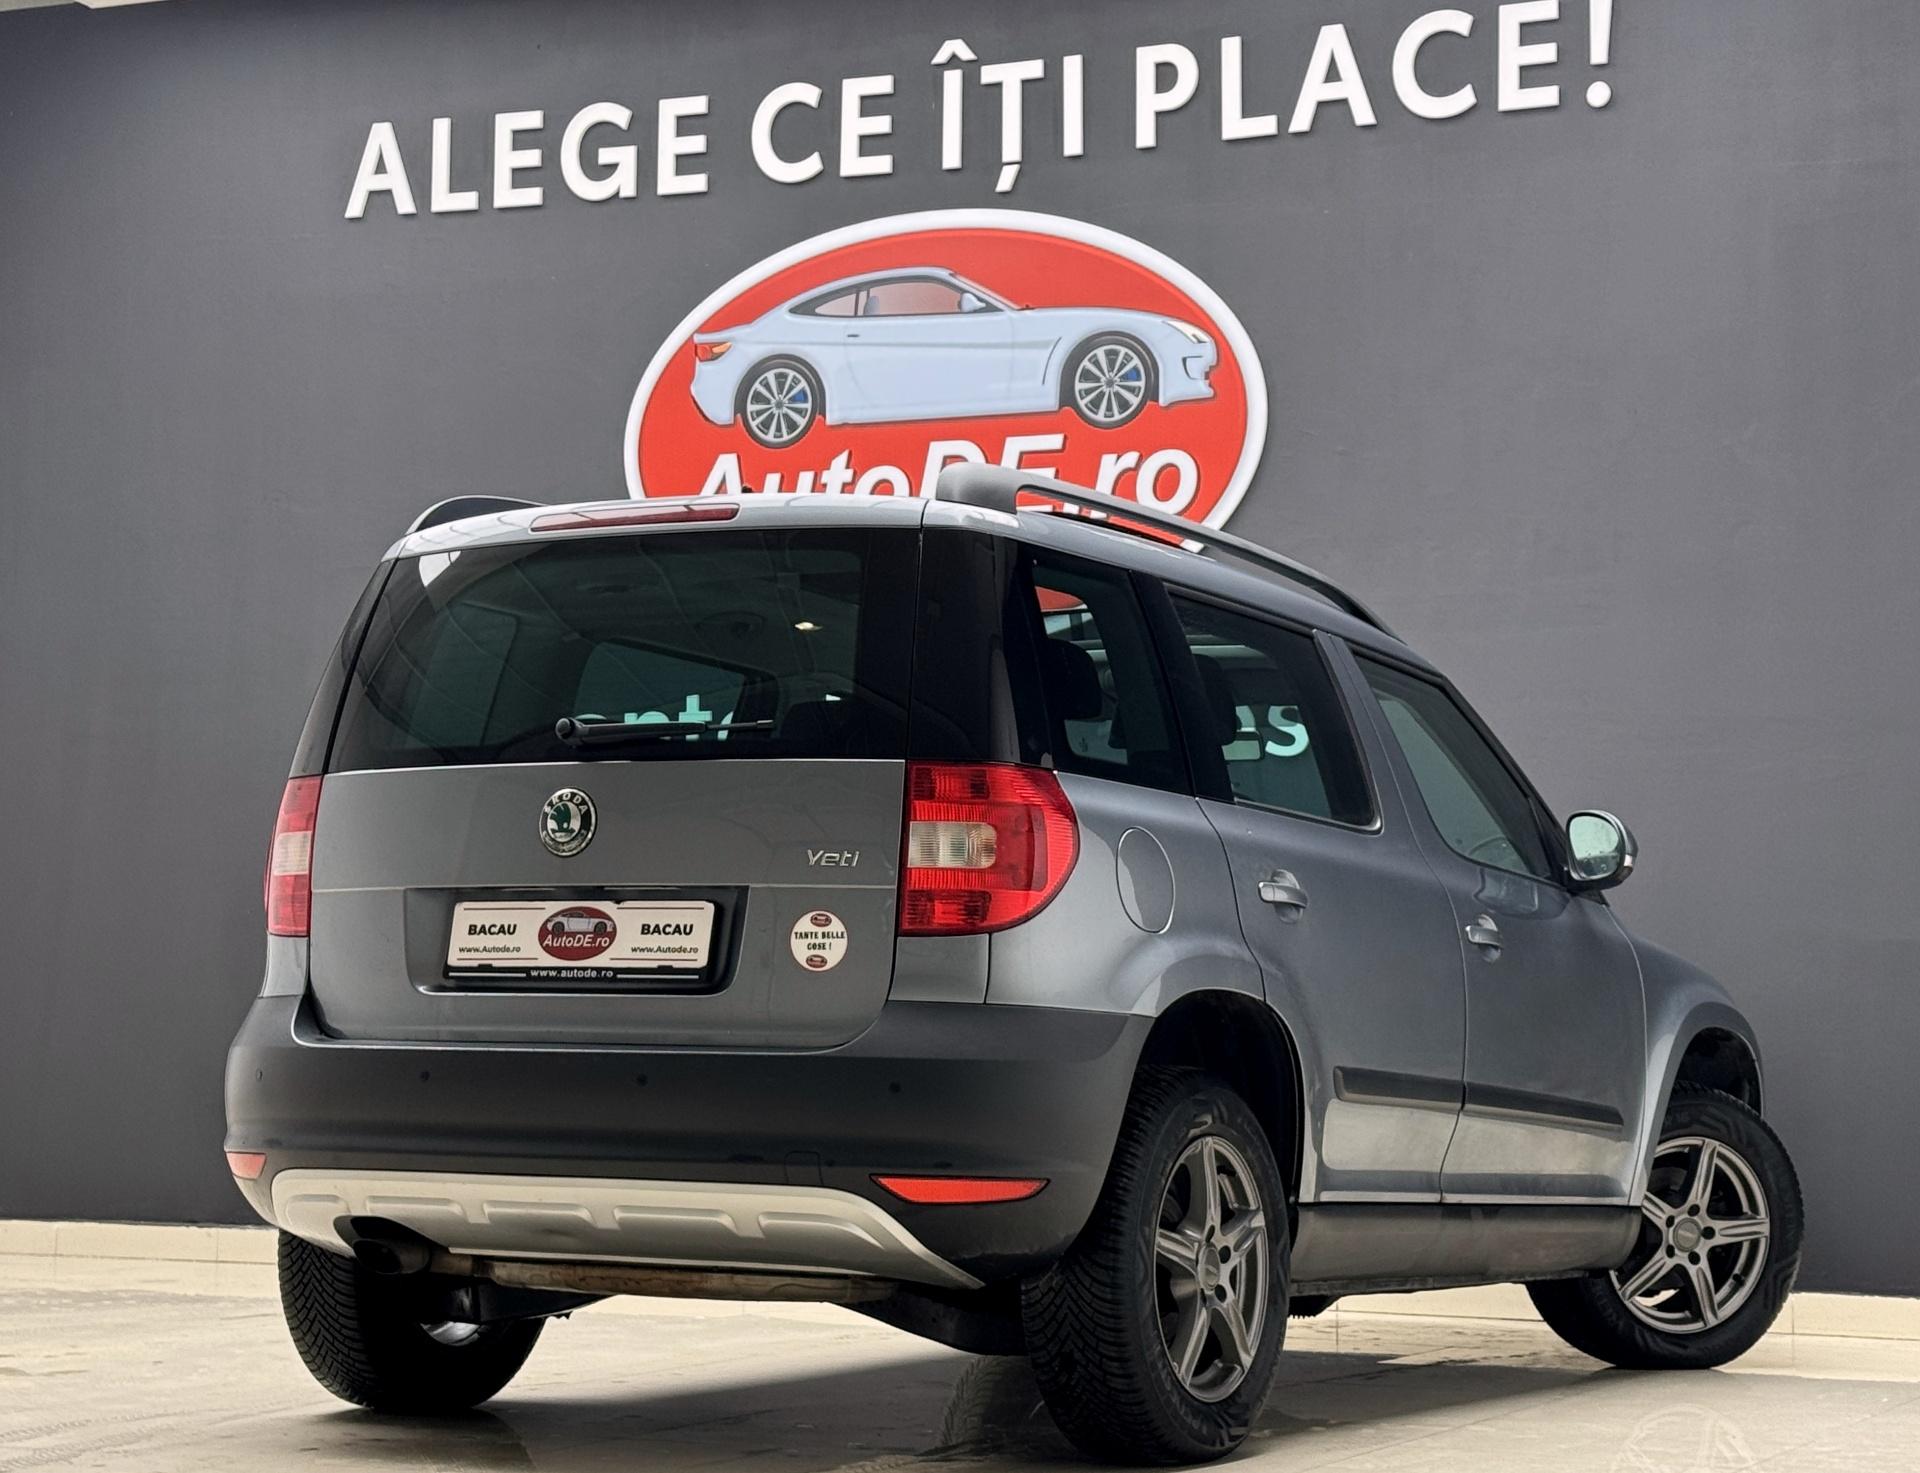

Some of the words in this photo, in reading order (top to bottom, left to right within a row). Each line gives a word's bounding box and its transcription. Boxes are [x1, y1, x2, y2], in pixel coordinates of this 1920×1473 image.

[344, 95, 709, 219] ALEGE
[750, 75, 894, 184] CE
[931, 38, 1085, 193] ÎȚI
[1134, 0, 1613, 150] PLACE!
[807, 848, 860, 868] Yeti
[467, 923, 518, 936] BACAU
[640, 923, 696, 937] BACAU
[793, 931, 819, 941] TANTE
[821, 931, 846, 940] BELLE
[543, 934, 611, 948] AutoDE.ro
[458, 944, 522, 954] www.Autode.ro
[631, 945, 700, 955] www.Autode.ro
[529, 968, 614, 979] www.autode.ro
